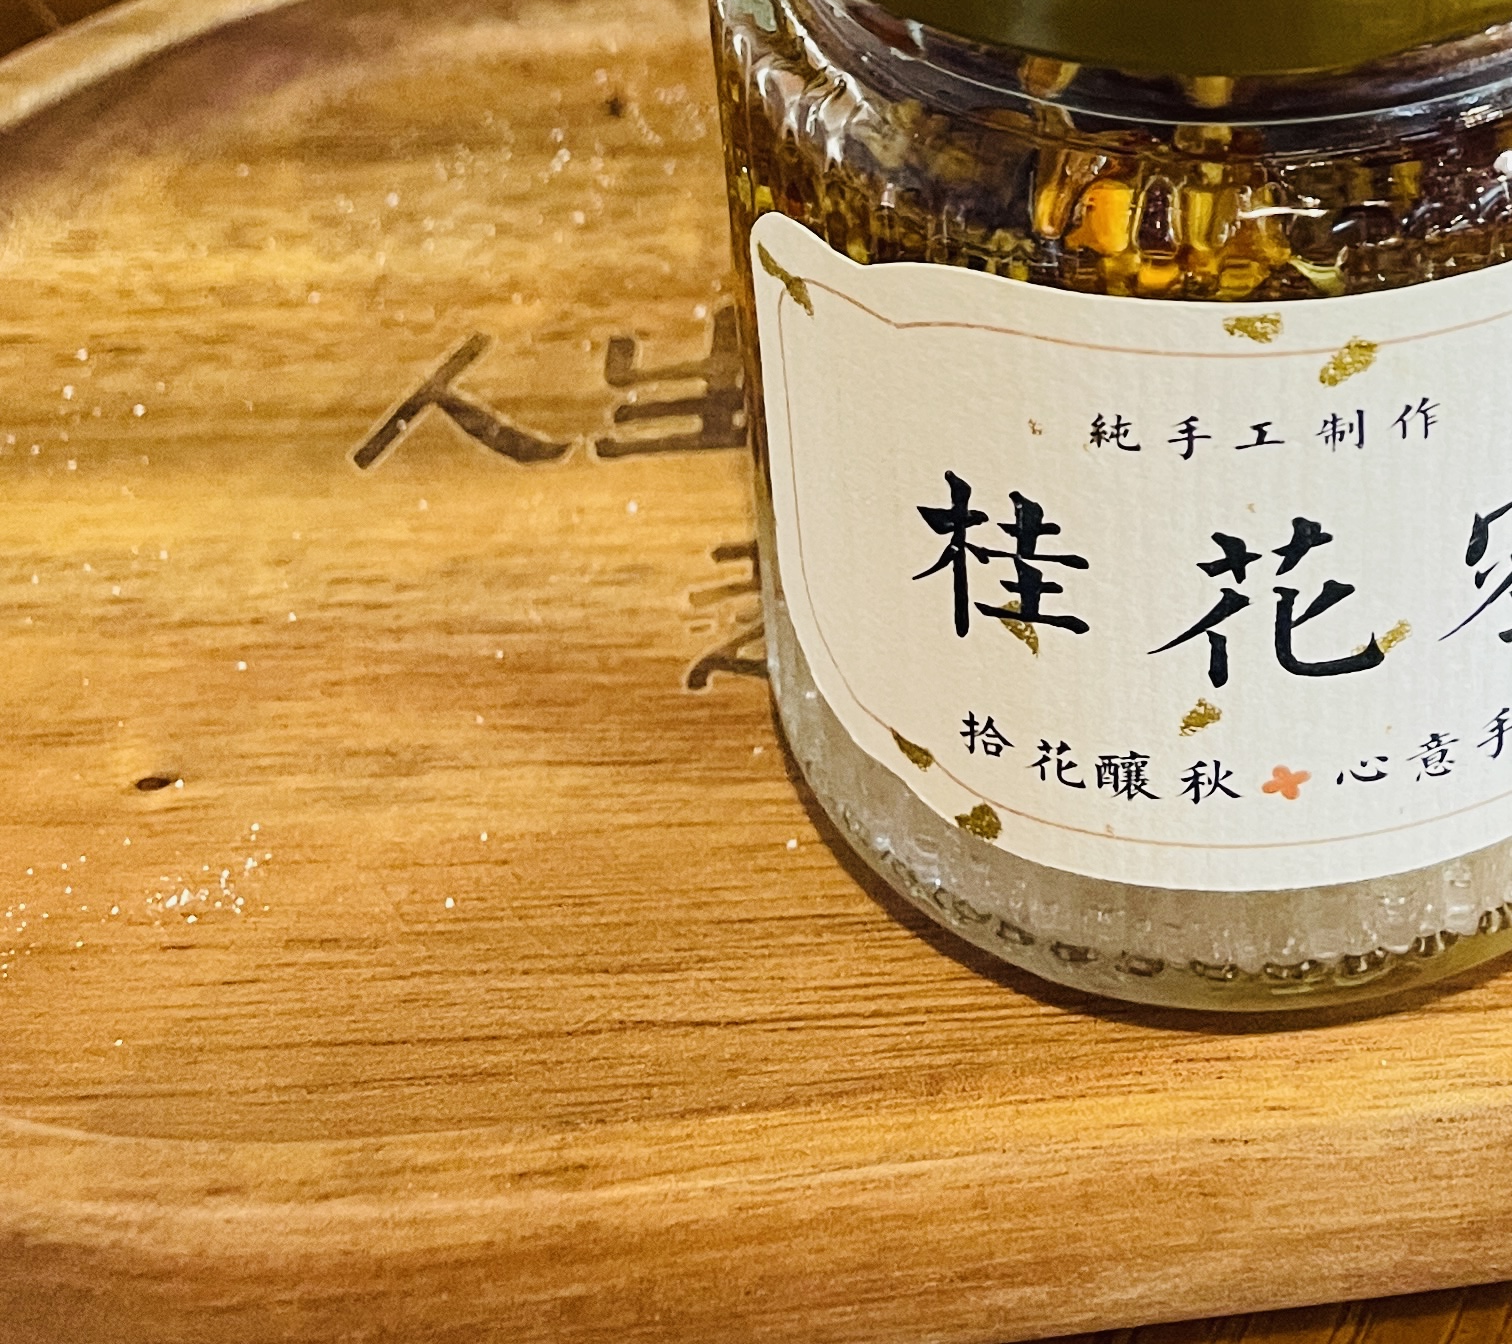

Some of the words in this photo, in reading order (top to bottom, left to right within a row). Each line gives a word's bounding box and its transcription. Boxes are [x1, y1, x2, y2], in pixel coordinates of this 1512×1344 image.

[1089, 396, 1441, 461] 純手工制作
[958, 710, 1244, 806] 拾花釀秋
